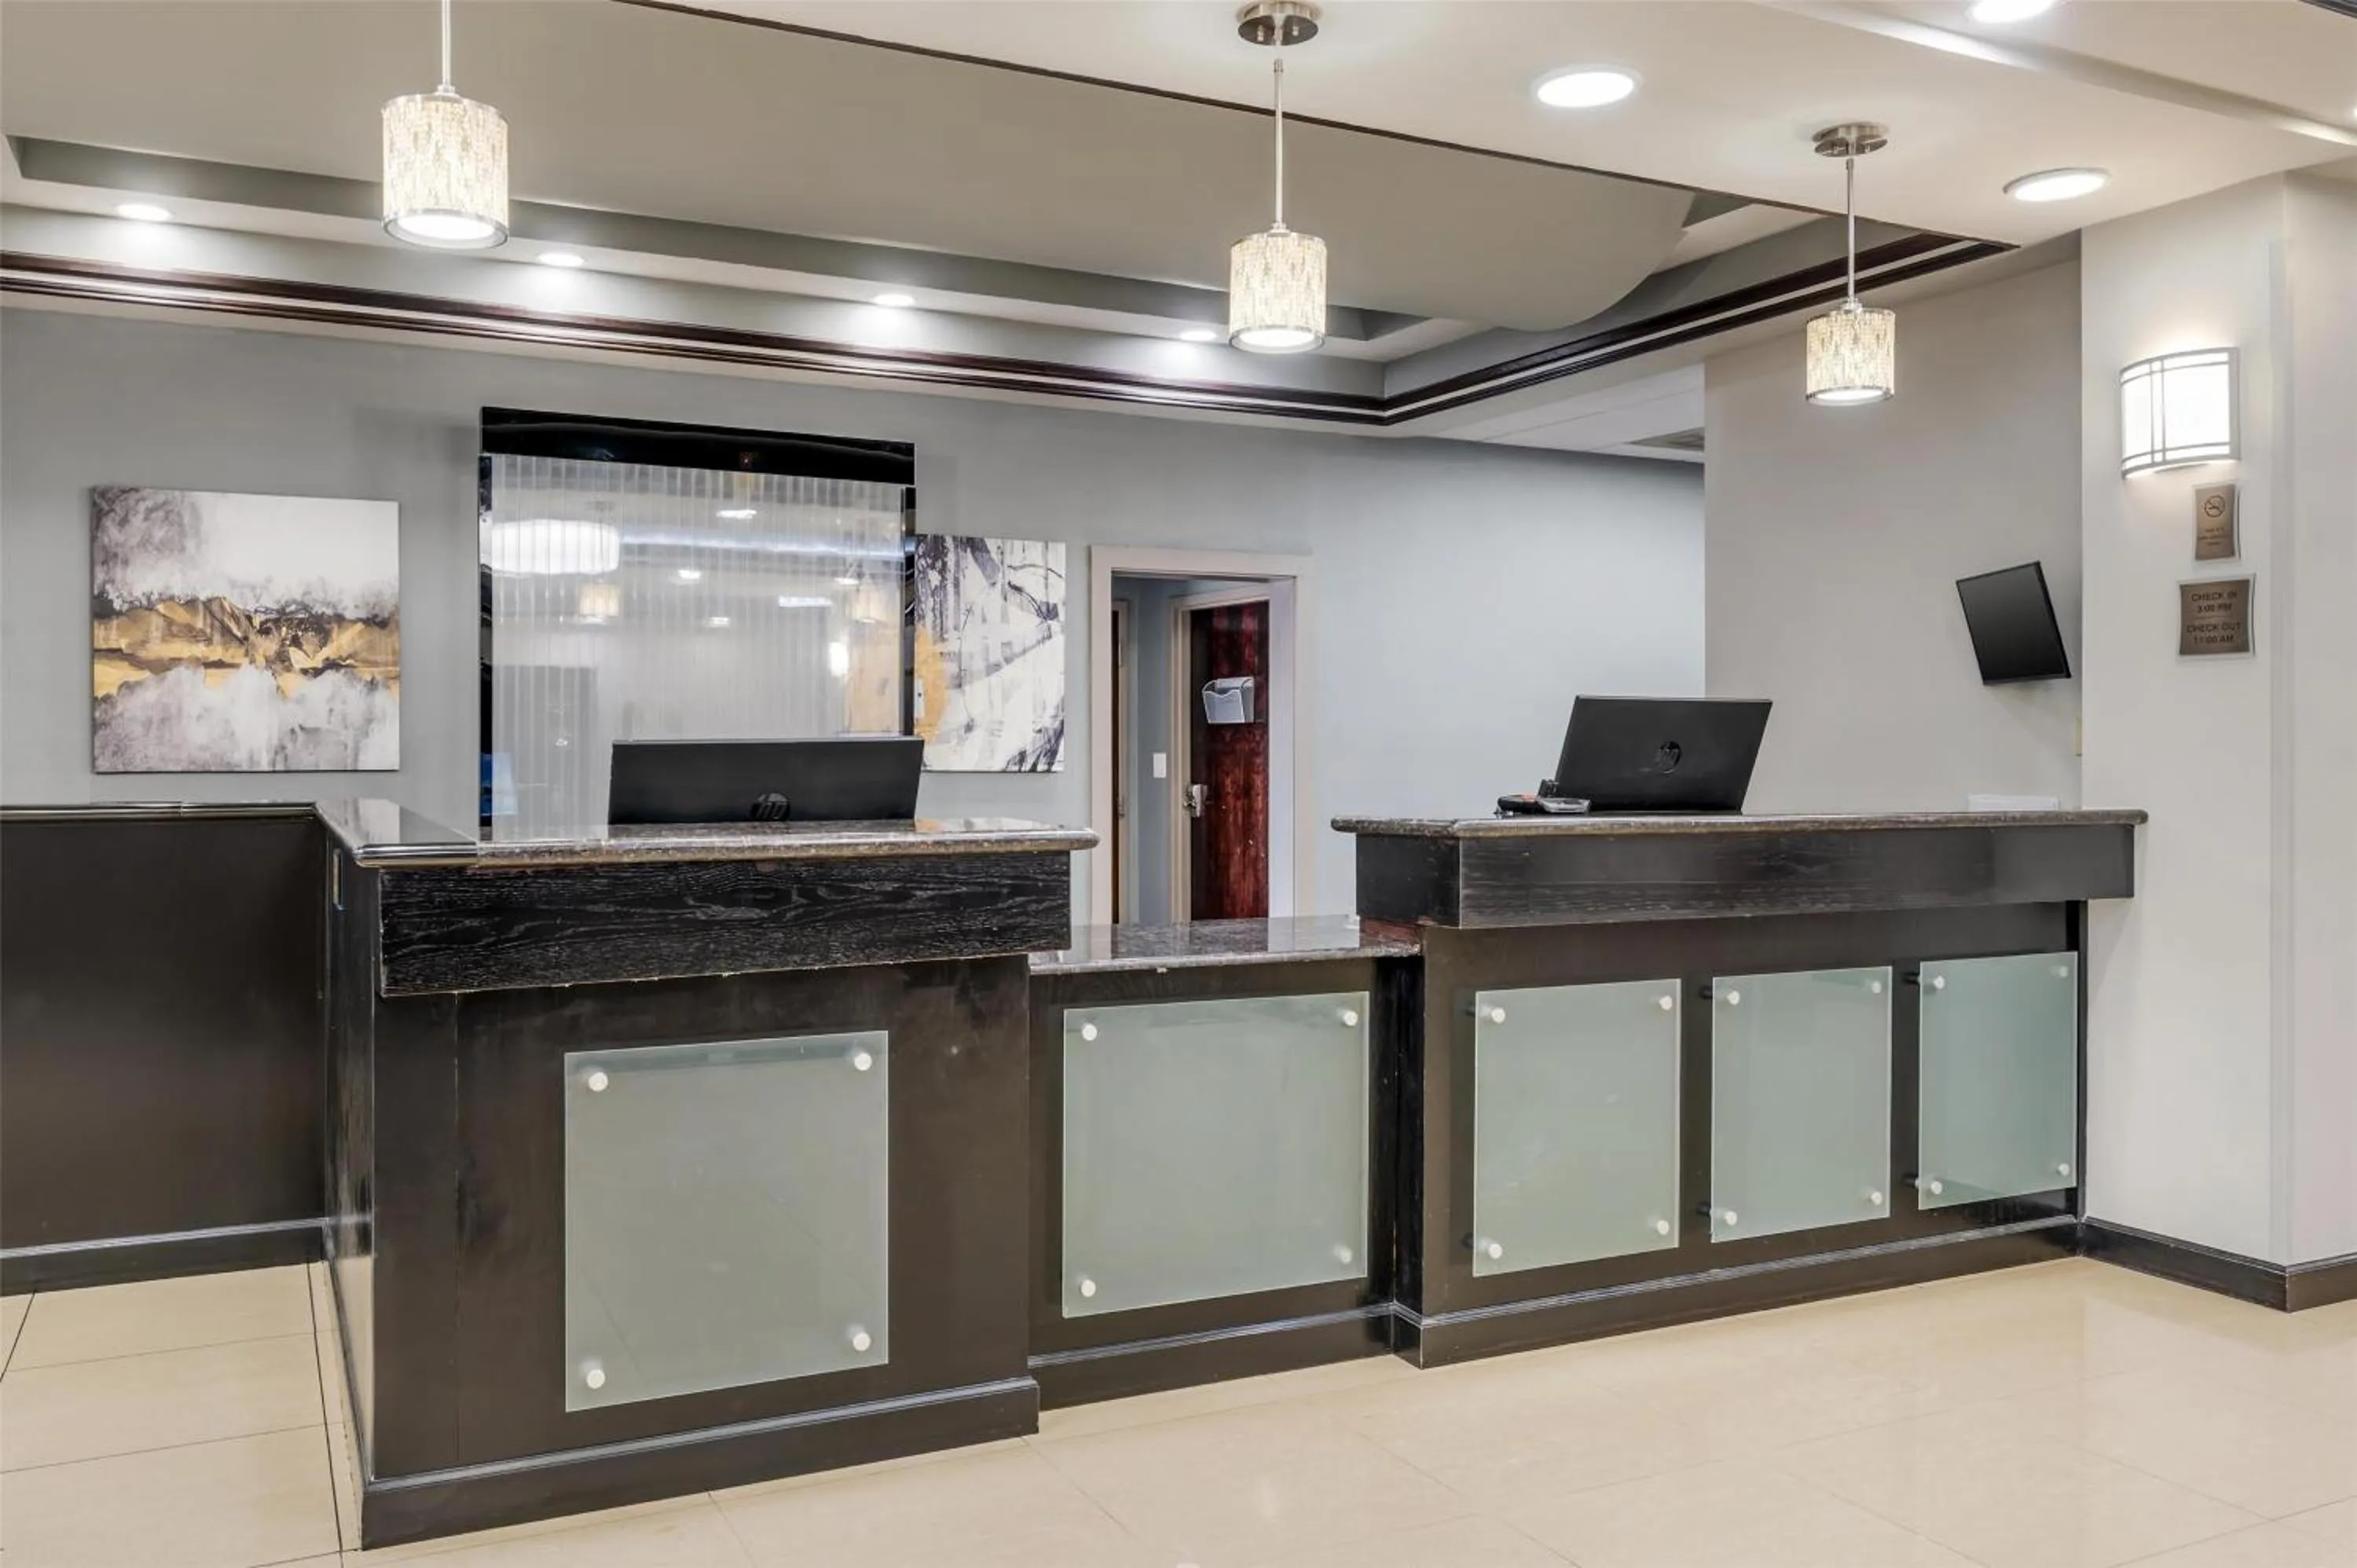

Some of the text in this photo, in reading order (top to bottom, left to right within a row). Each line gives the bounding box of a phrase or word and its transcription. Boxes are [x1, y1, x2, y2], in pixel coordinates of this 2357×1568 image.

[2190, 591, 2238, 602] CHECK IN
[2186, 622, 2242, 633] CHECK OUT
[2220, 634, 2235, 643] AM
